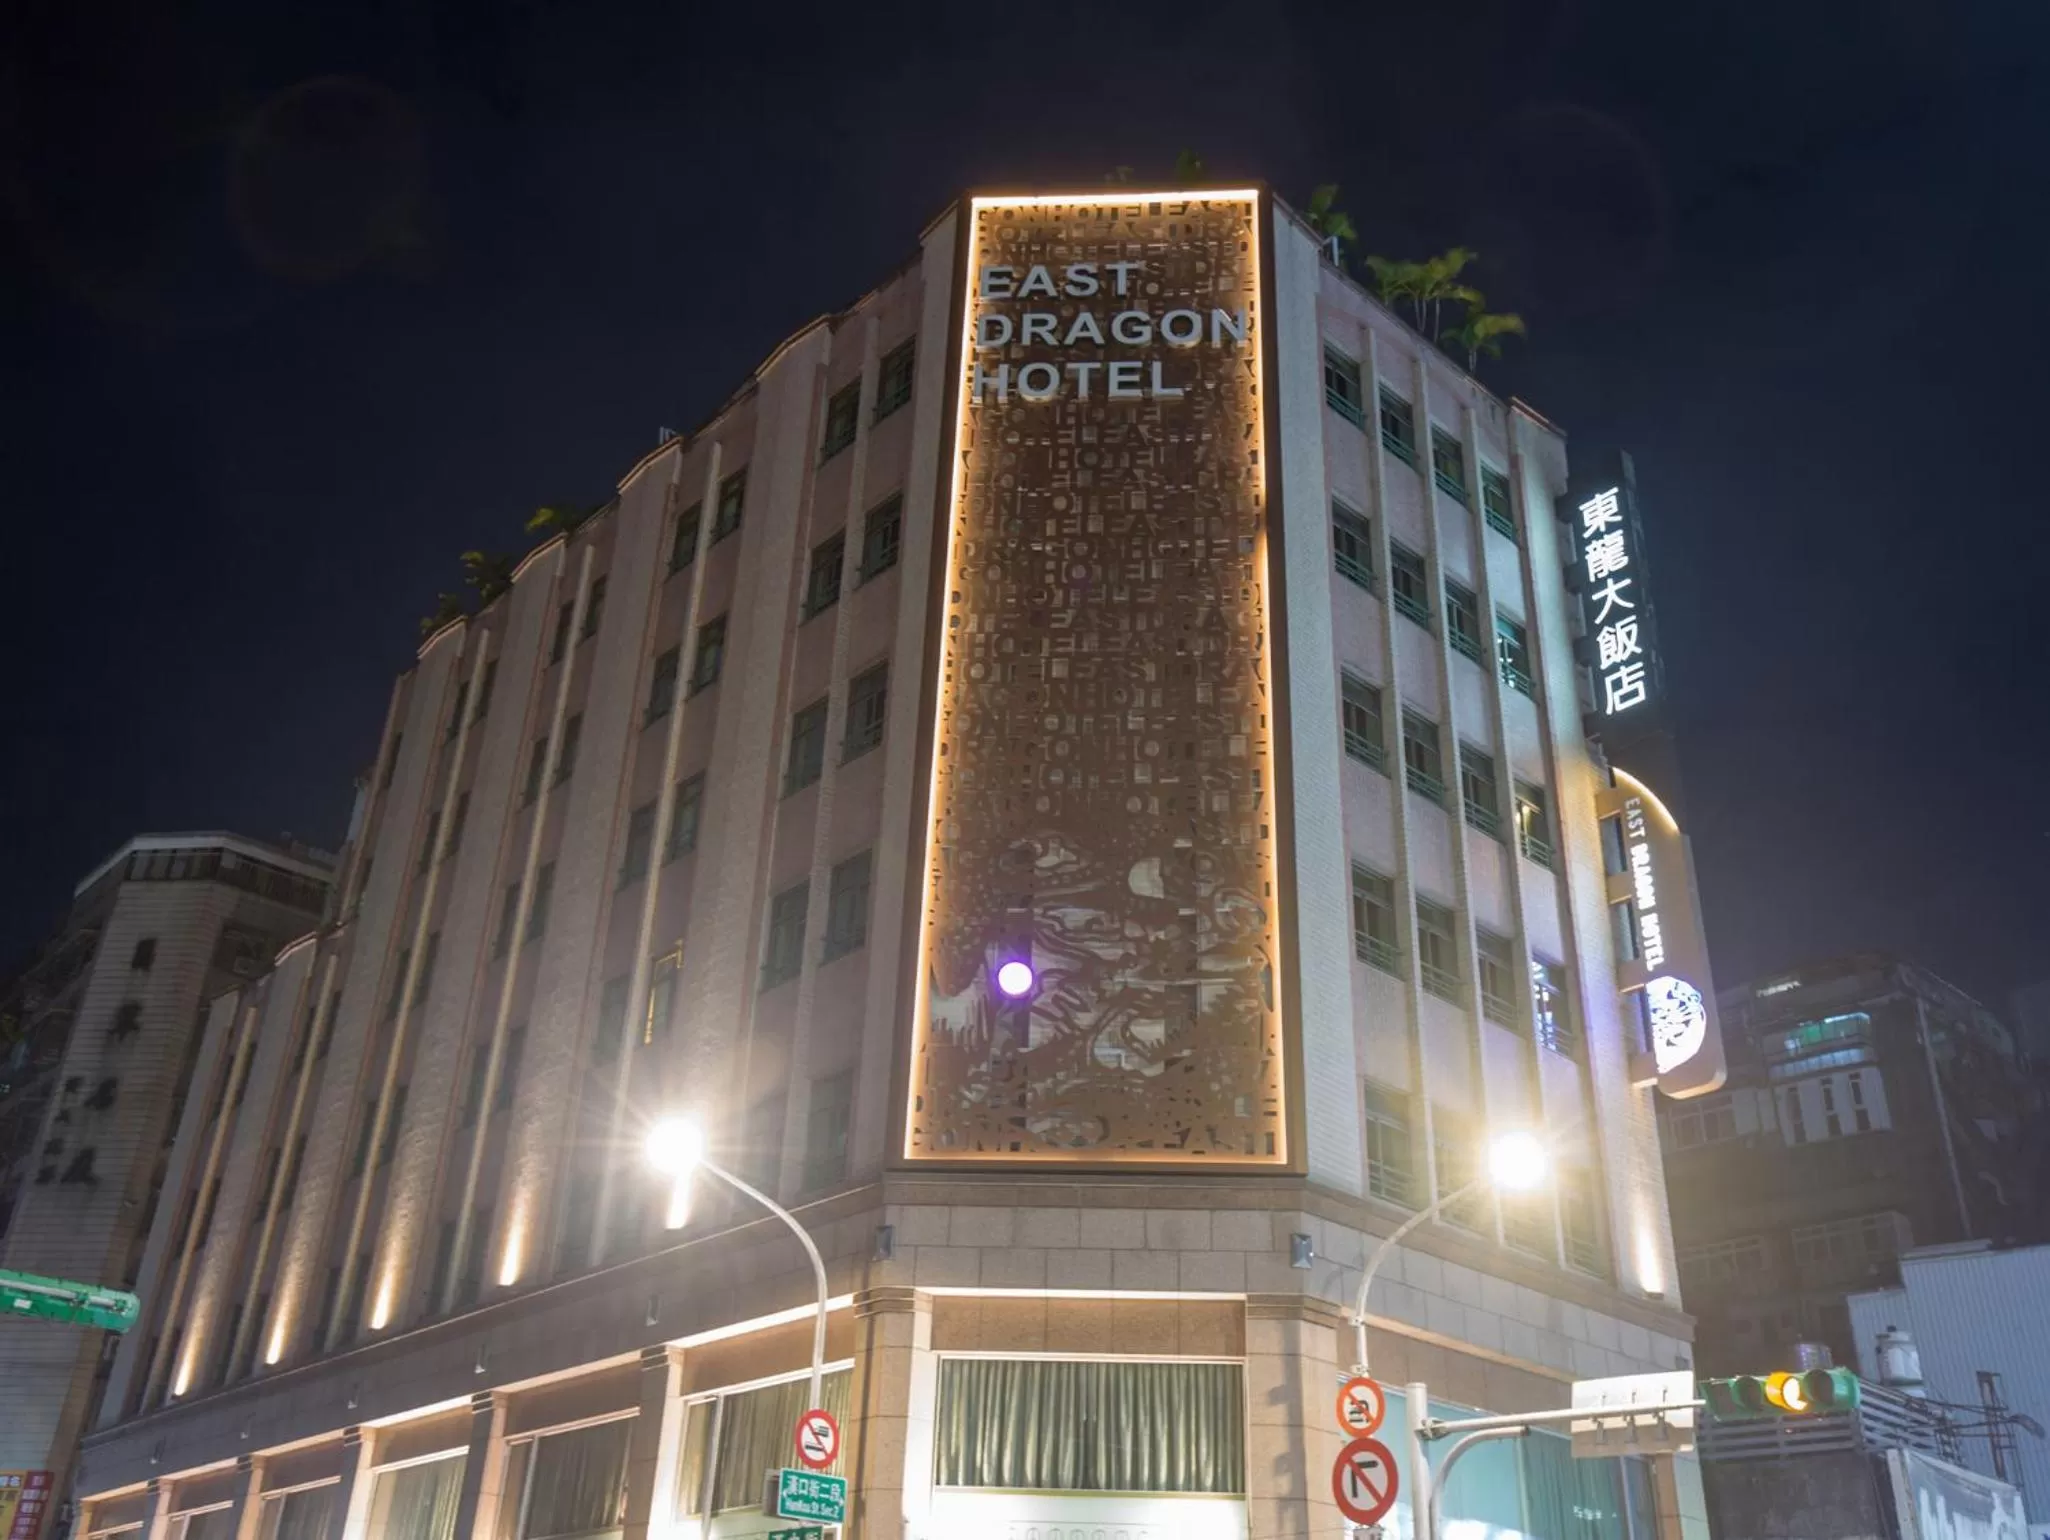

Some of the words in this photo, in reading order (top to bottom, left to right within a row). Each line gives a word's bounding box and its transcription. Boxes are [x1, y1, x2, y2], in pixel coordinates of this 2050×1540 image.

[979, 260, 1140, 299] EAST
[976, 307, 1247, 349] DRAGON
[972, 360, 1184, 403] HOTEL
[1578, 486, 1647, 716] 東龍大飯店
[1625, 796, 1646, 839] EAST
[1639, 912, 1665, 972] HOTEL
